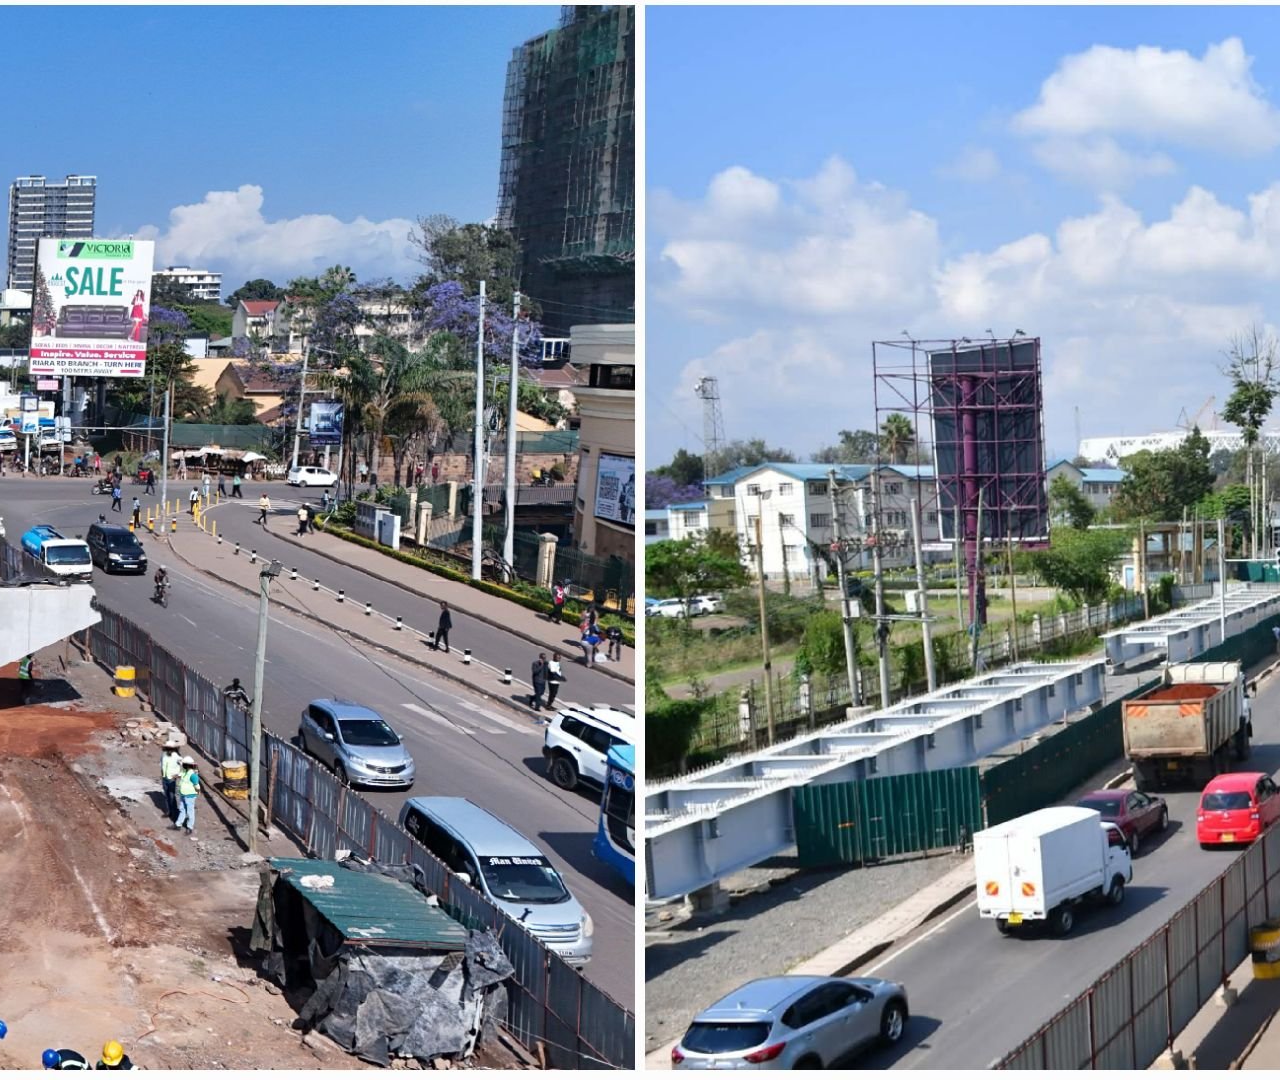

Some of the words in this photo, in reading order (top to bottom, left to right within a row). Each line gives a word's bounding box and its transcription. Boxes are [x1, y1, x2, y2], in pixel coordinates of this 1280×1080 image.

[65, 266, 124, 296] SALE
[489, 857, 511, 866] Man
[511, 856, 543, 866] United
